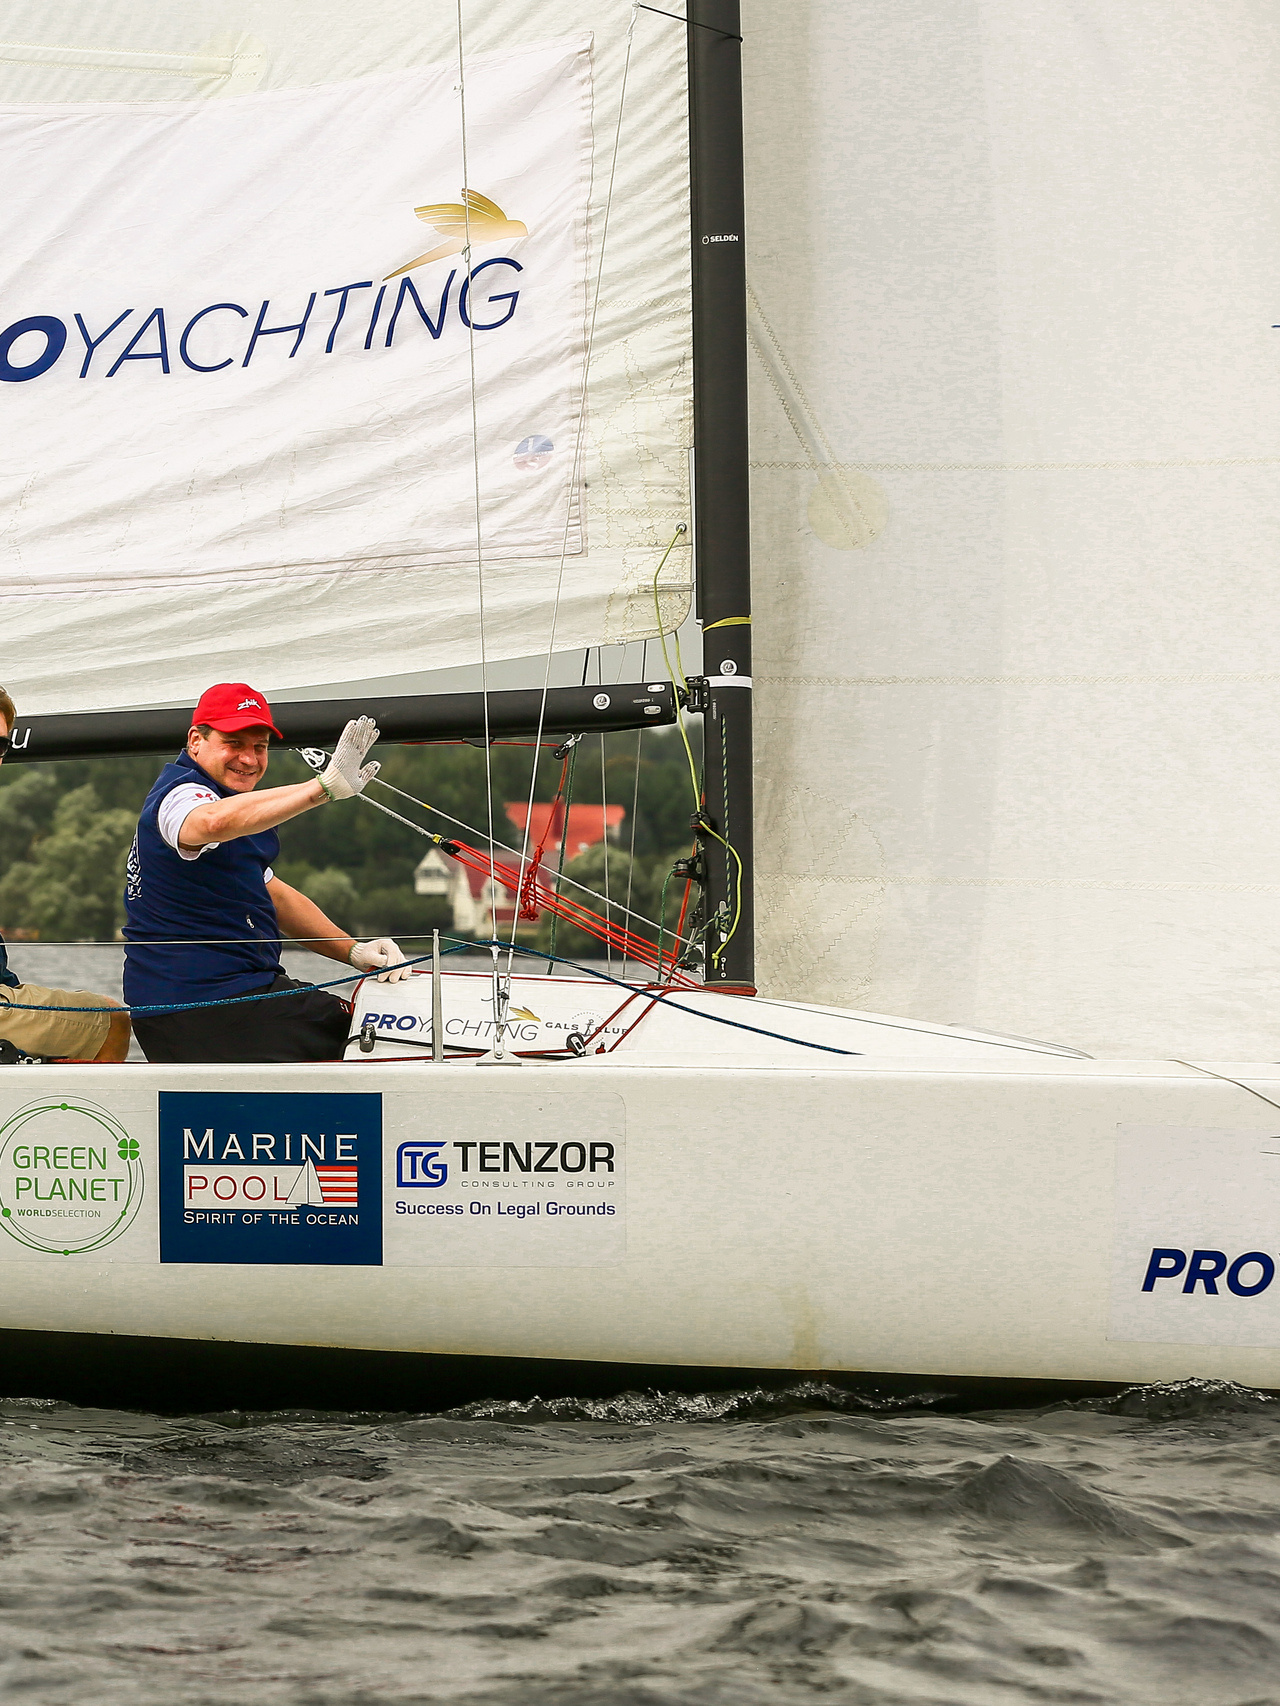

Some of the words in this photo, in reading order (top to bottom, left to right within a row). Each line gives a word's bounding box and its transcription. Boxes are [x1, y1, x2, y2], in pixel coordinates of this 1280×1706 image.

[237, 699, 261, 710] zhik
[545, 1021, 579, 1031] GALS
[183, 1128, 358, 1161] MARINE
[13, 1146, 106, 1170] GREEN
[453, 1141, 615, 1172] TENZOR
[16, 1177, 124, 1201] PLANET
[188, 1175, 289, 1201] POOL
[461, 1180, 555, 1188] CONSULTING
[566, 1180, 615, 1188] GROUP
[17, 1209, 101, 1218] WORLDSELECTION
[183, 1211, 236, 1224] SPIRIT
[242, 1213, 263, 1224] OF
[269, 1213, 300, 1225] THE
[306, 1213, 359, 1225] OCEAN
[395, 1201, 464, 1215] Success
[470, 1201, 491, 1215] On
[497, 1201, 540, 1219] Legal
[546, 1201, 616, 1216] Grounds
[1141, 1247, 1280, 1297] PRO
